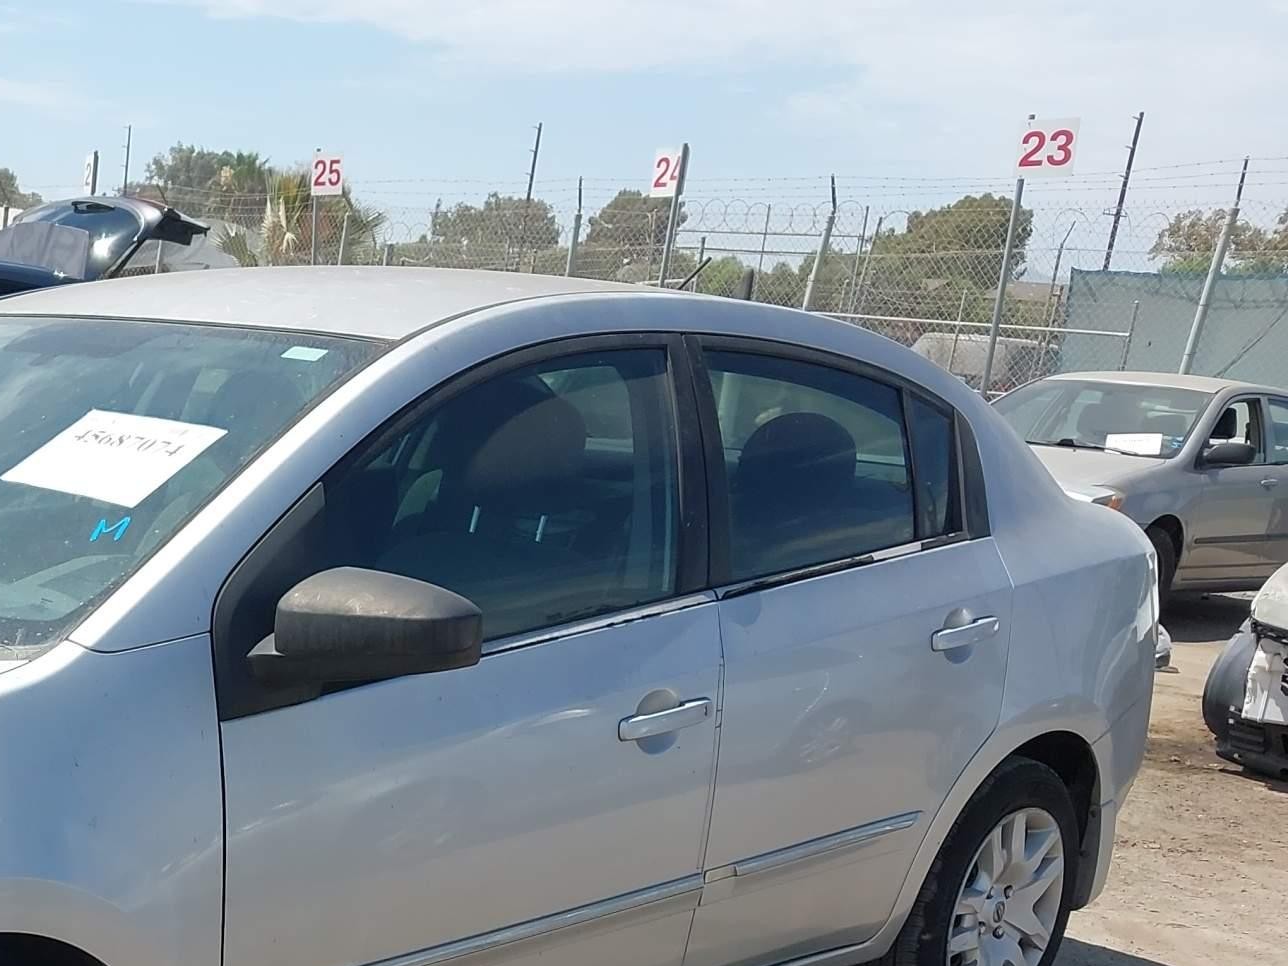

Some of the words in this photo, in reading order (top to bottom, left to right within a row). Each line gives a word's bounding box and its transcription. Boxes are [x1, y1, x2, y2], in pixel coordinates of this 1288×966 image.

[1018, 129, 1074, 167] 23
[85, 162, 92, 187] 2
[314, 160, 341, 187] 25
[74, 429, 185, 457] 45687074
[89, 516, 131, 542] M
